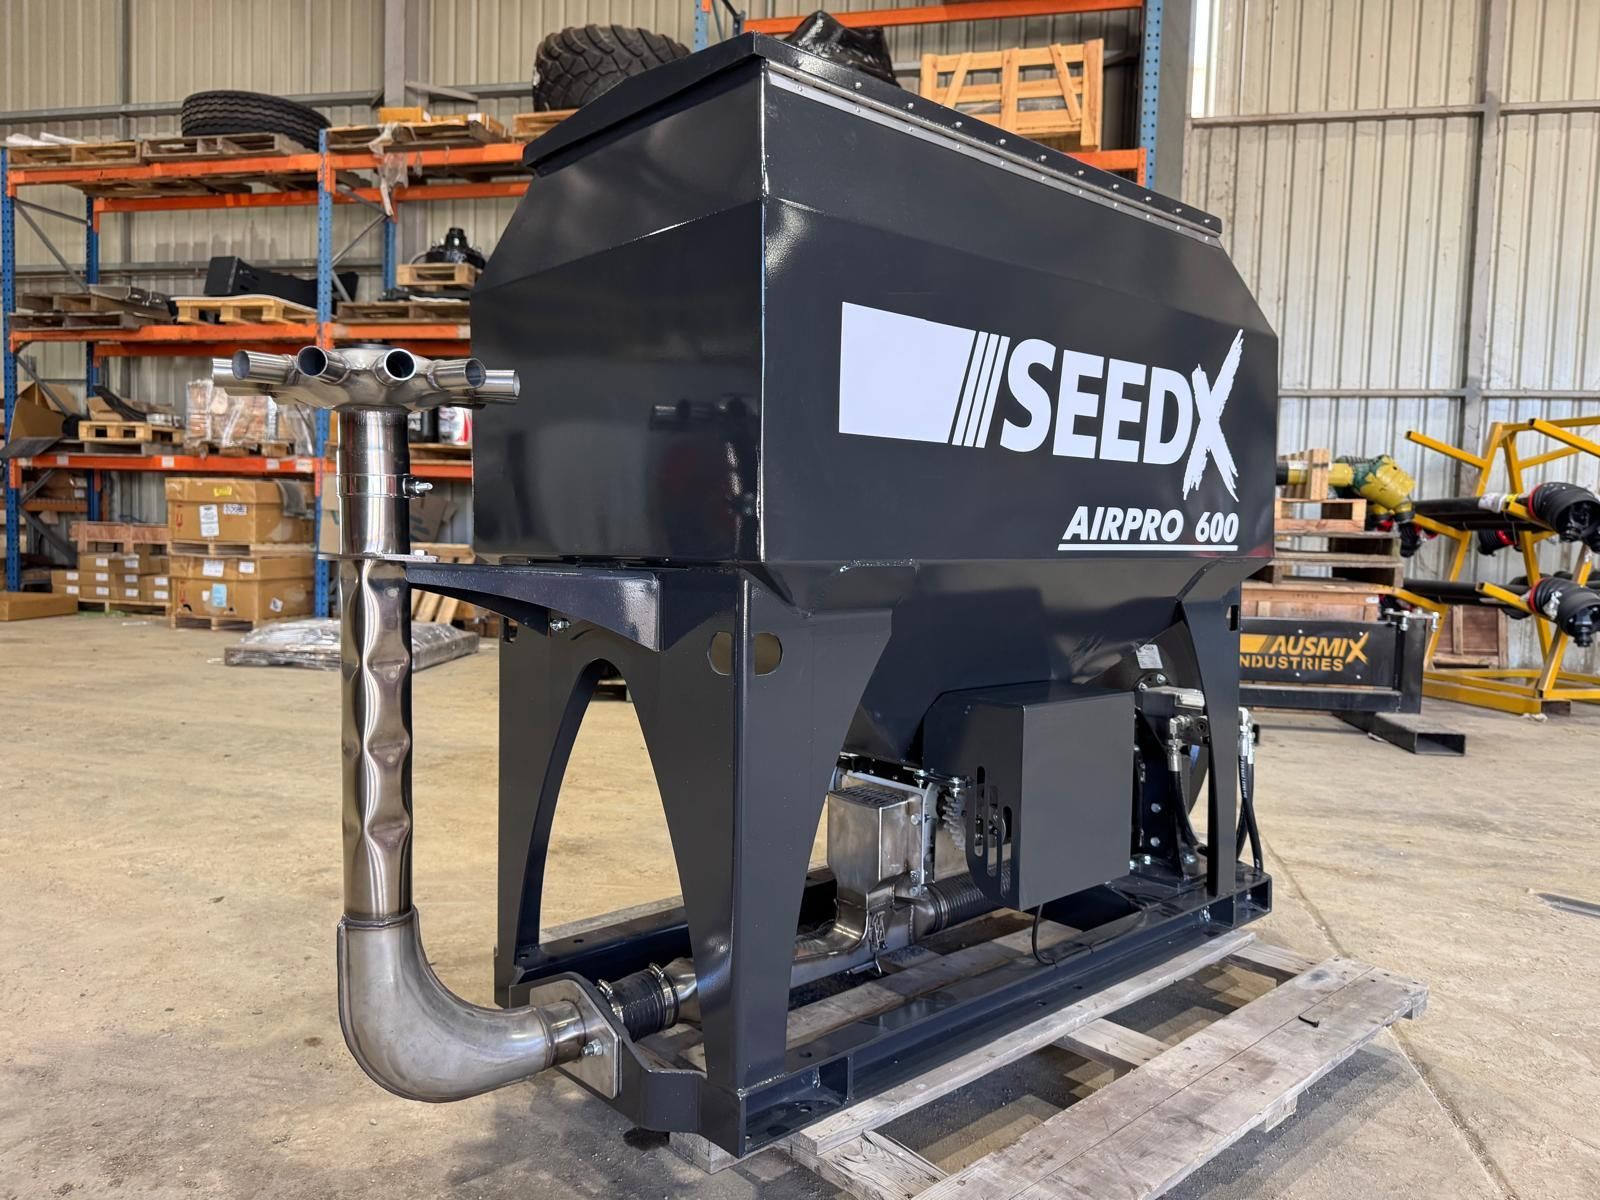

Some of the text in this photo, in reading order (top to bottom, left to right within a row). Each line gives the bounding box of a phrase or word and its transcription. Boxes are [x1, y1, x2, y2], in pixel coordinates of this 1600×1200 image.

[1000, 329, 1243, 502] SEEDX
[1062, 506, 1239, 542] AIRPRO 600
[1240, 654, 1344, 672] NDUSTRIES
[1269, 632, 1369, 665] AUSMIX
